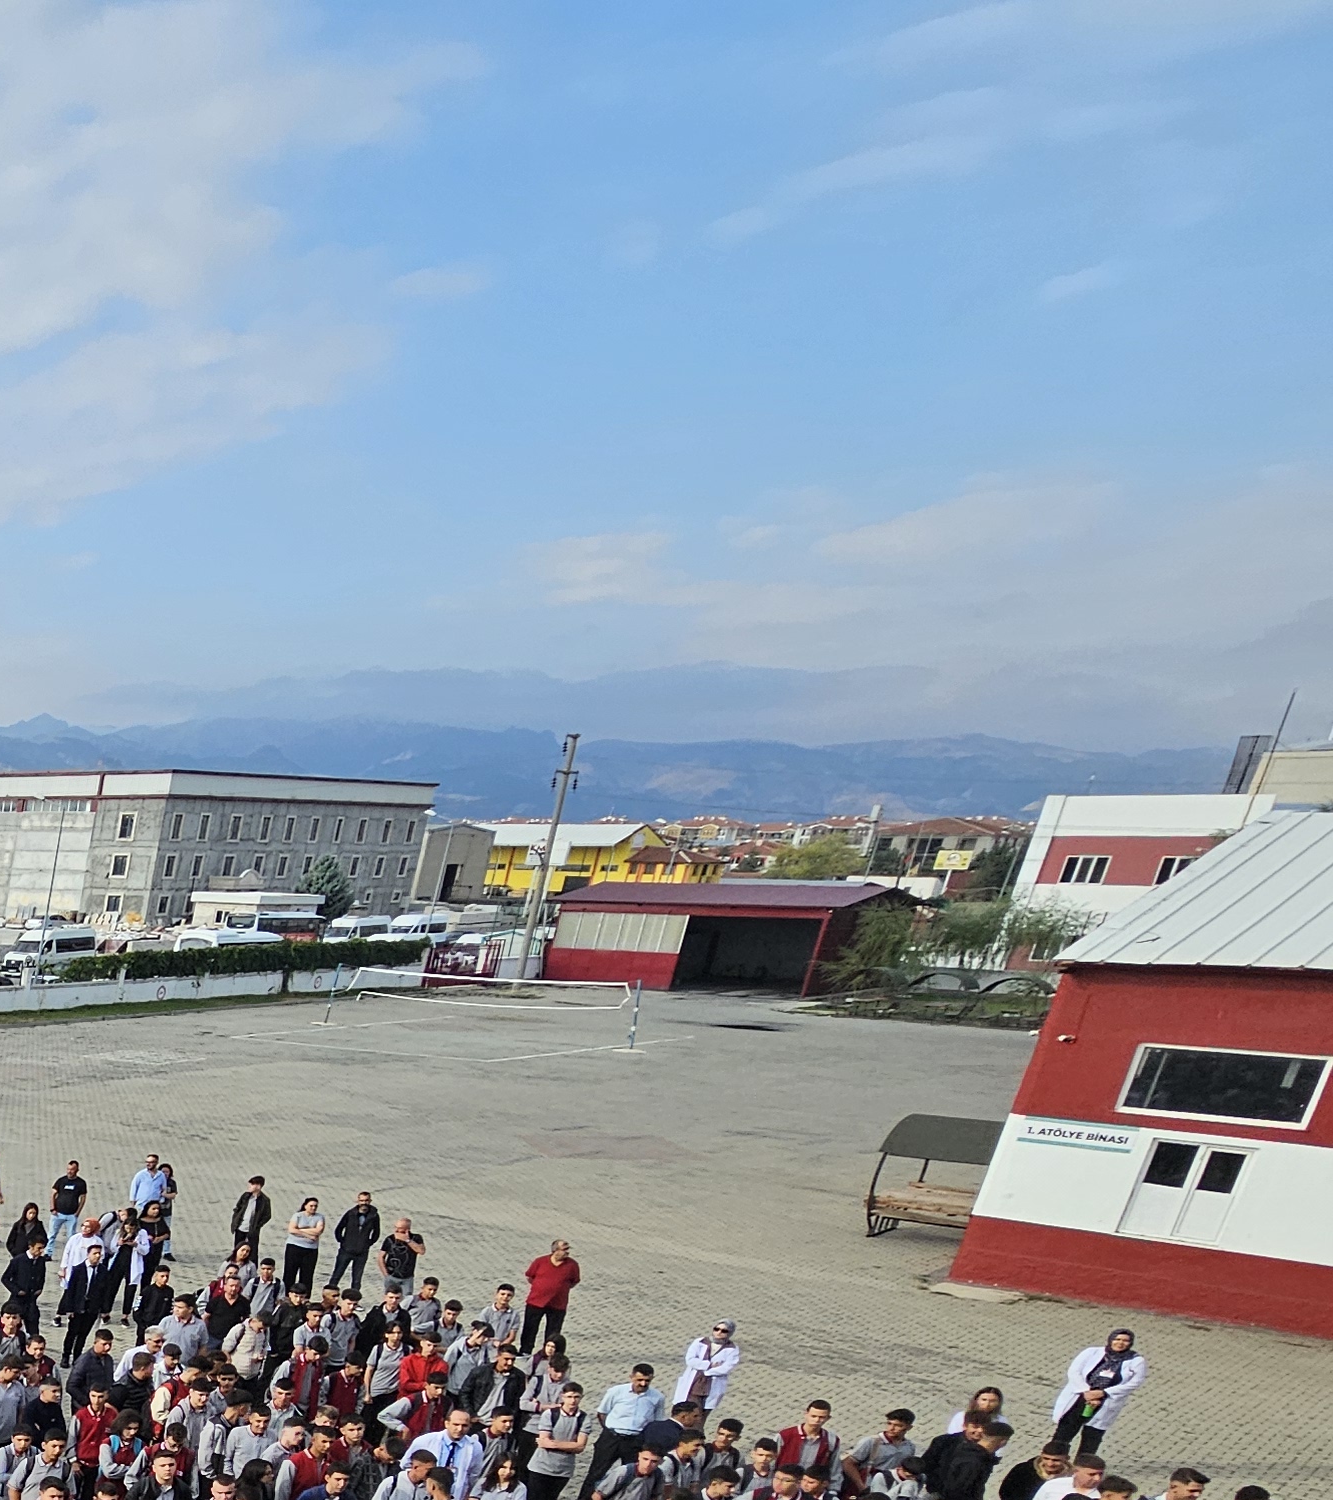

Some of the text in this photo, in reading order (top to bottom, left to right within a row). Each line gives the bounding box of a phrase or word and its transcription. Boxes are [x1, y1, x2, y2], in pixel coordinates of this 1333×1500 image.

[1027, 1126, 1129, 1144] 1. ATÖLYE BİNASI
